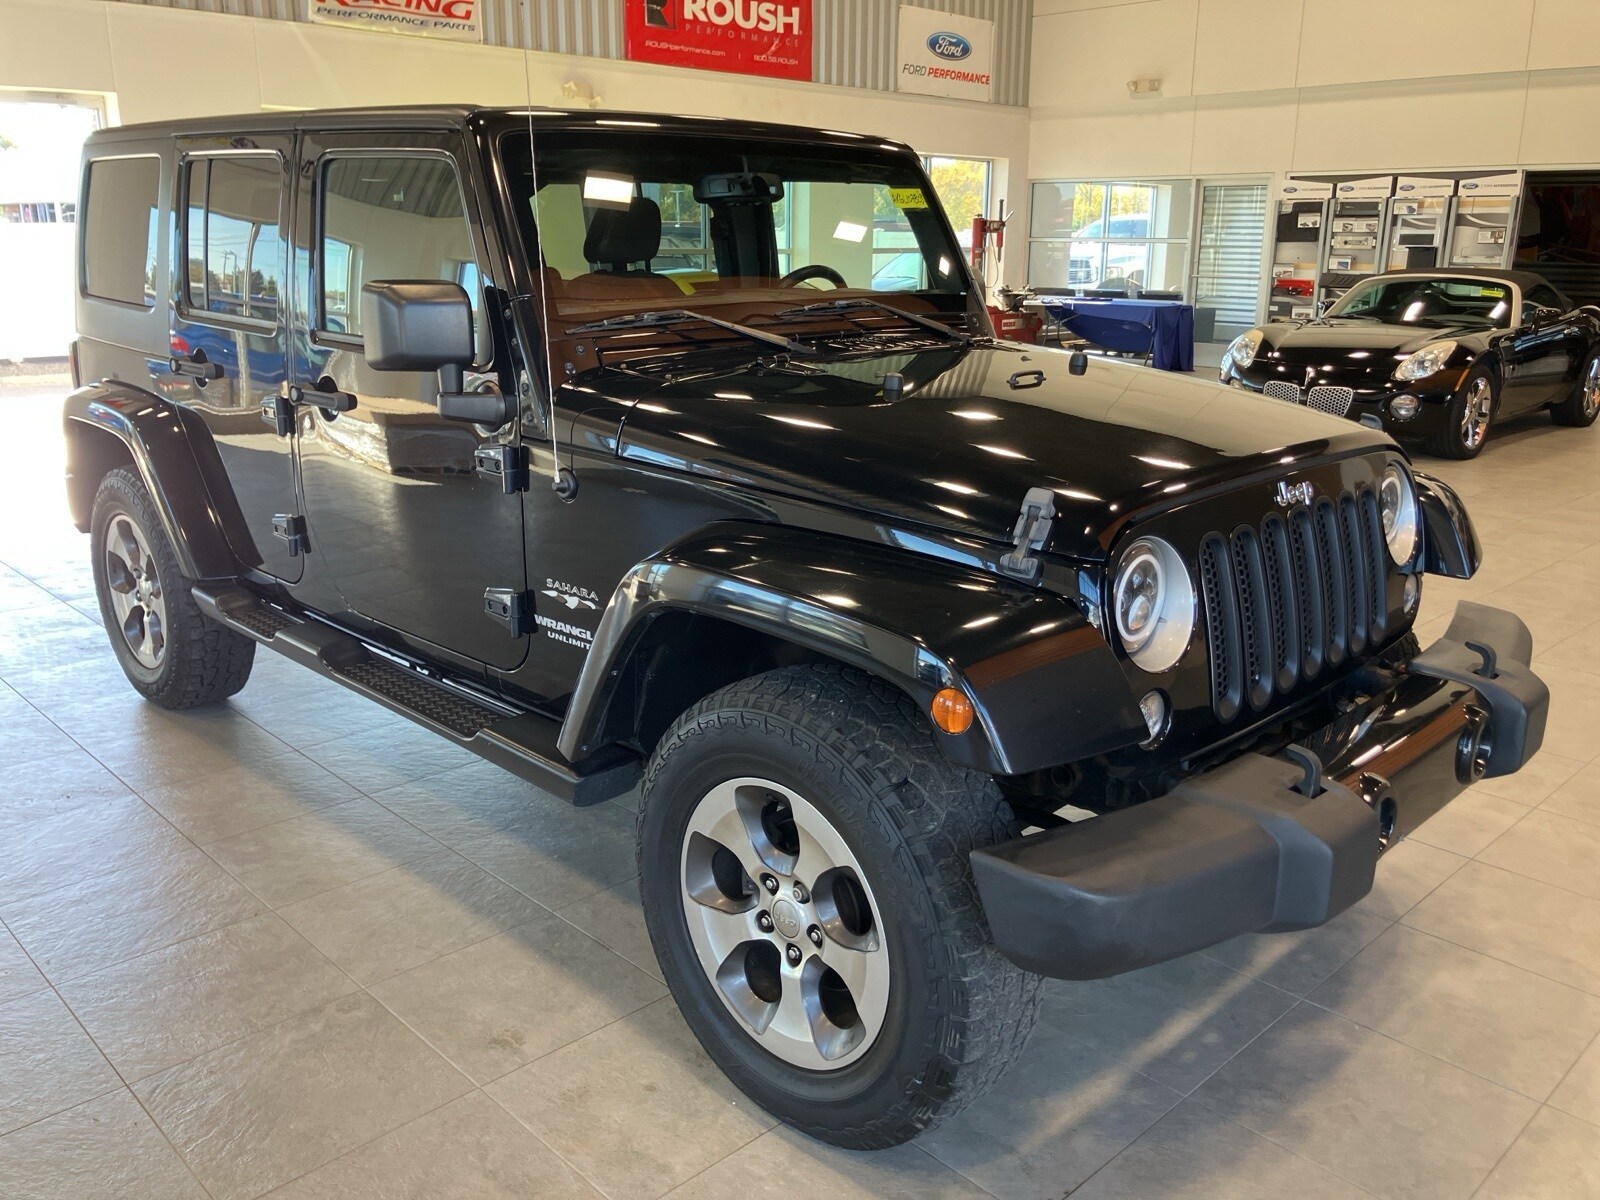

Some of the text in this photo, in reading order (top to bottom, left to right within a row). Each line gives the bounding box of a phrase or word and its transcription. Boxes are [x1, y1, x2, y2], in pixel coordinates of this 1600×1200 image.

[317, 6, 475, 31] PERFORMANCE PARTS
[683, 0, 799, 35] ROUSH
[685, 24, 799, 47] PERFORMANCE
[935, 35, 963, 57] Ford
[645, 40, 726, 56] ROUSHperformance.com
[902, 63, 990, 85] FORD PERFORMANCE
[1273, 480, 1314, 507] Jeep
[545, 578, 599, 602] SAHARA
[533, 613, 594, 641] WRANGL
[547, 630, 592, 650] UNLIMIT
